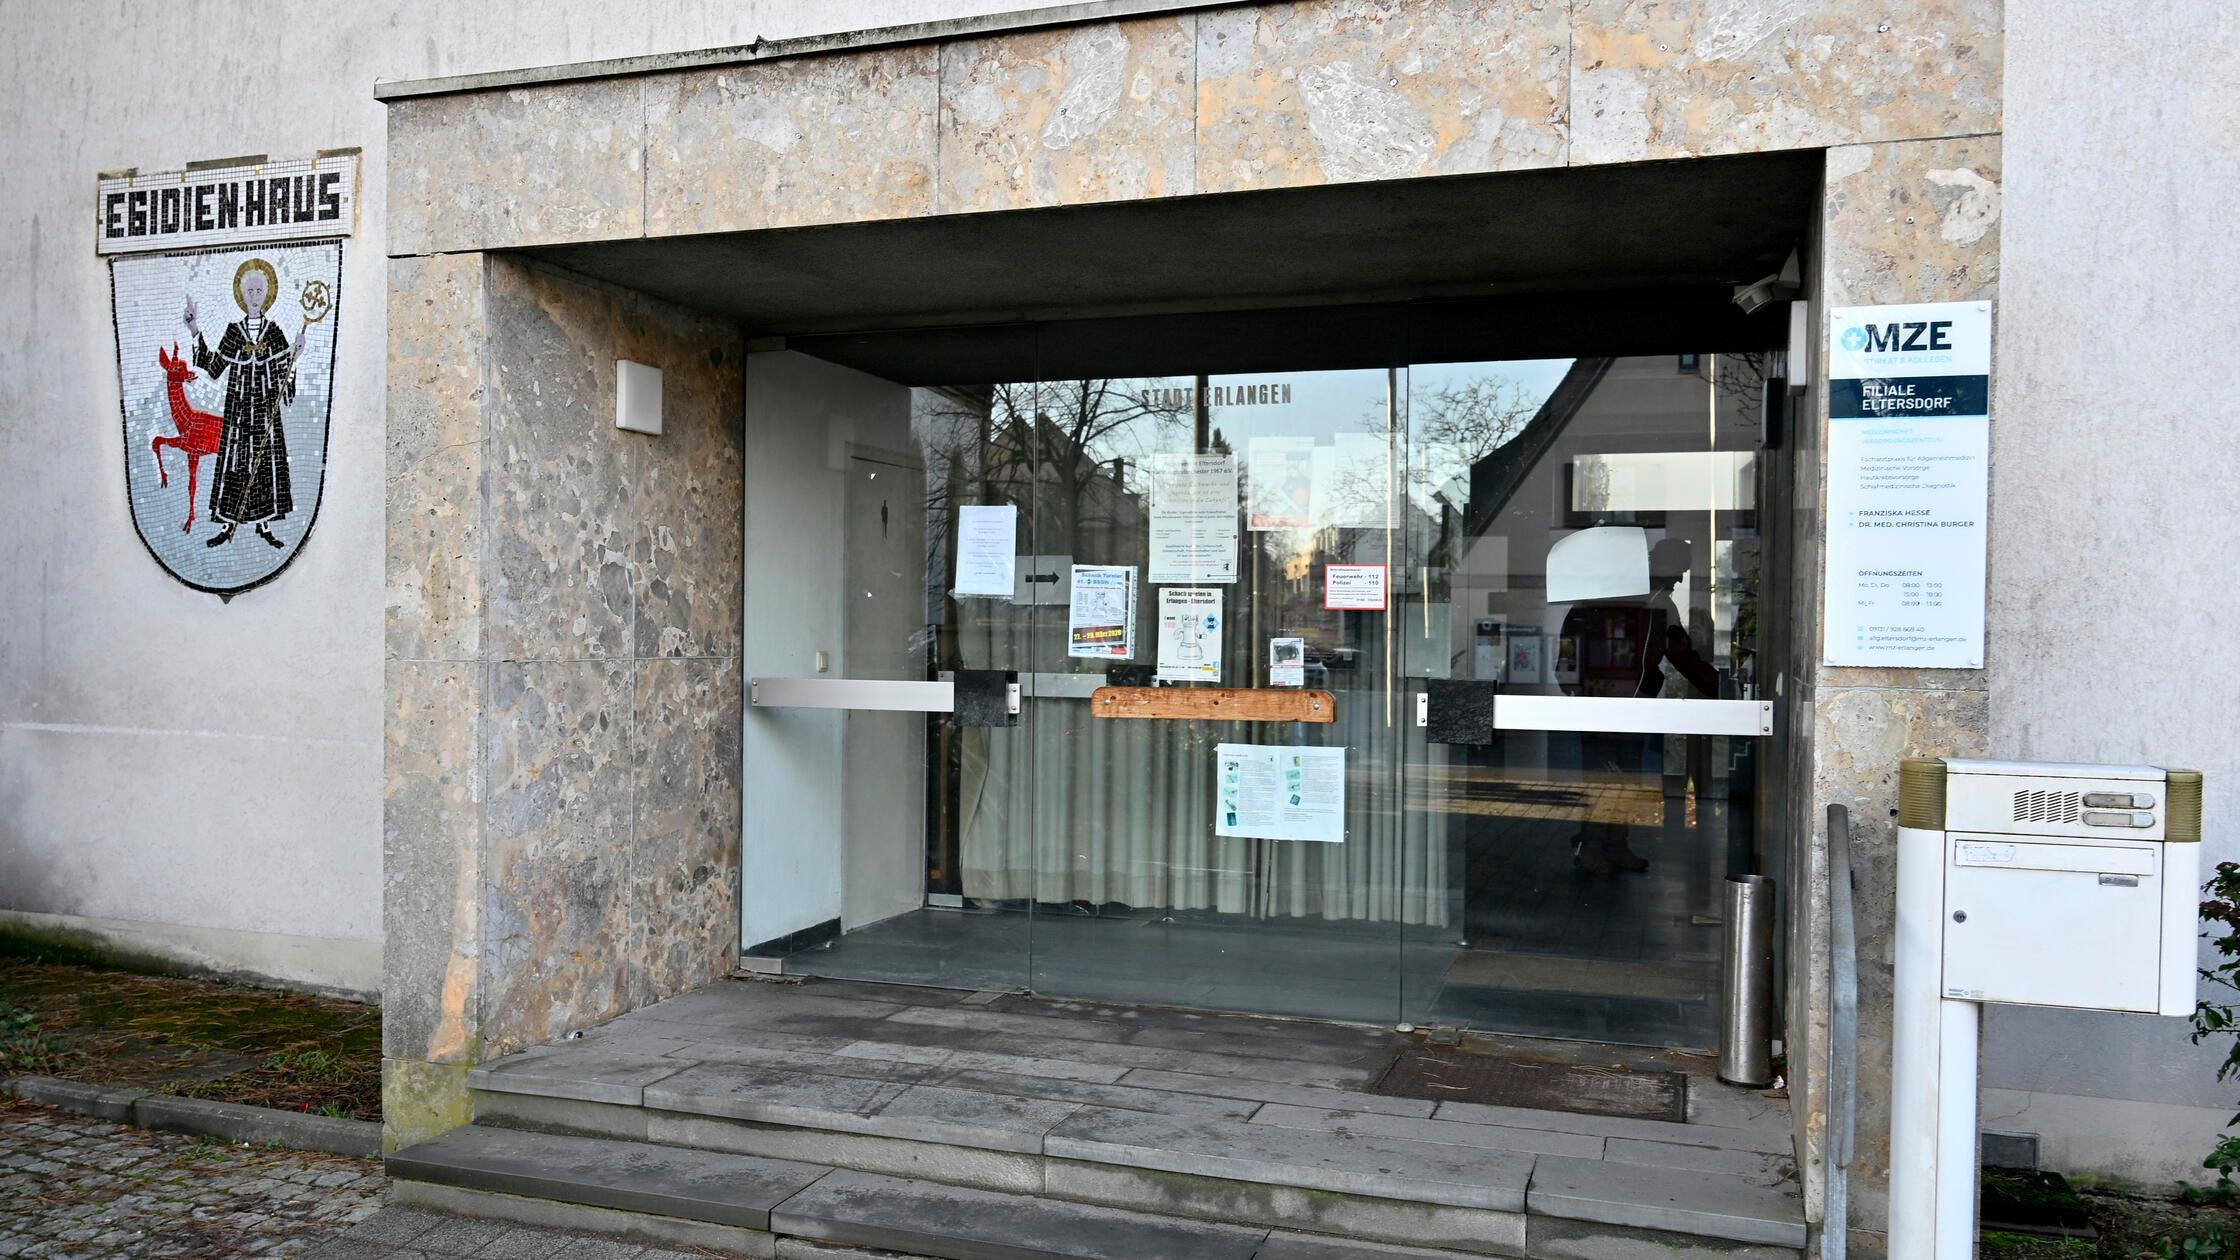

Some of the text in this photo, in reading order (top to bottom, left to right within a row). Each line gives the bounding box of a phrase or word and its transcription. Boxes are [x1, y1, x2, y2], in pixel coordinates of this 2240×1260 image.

[1864, 320, 1953, 353] MZE
[1141, 383, 1292, 407] STADT ERLANGEN
[1862, 384, 1916, 396] FILIALE
[1862, 397, 1953, 410] ELTERSDORF
